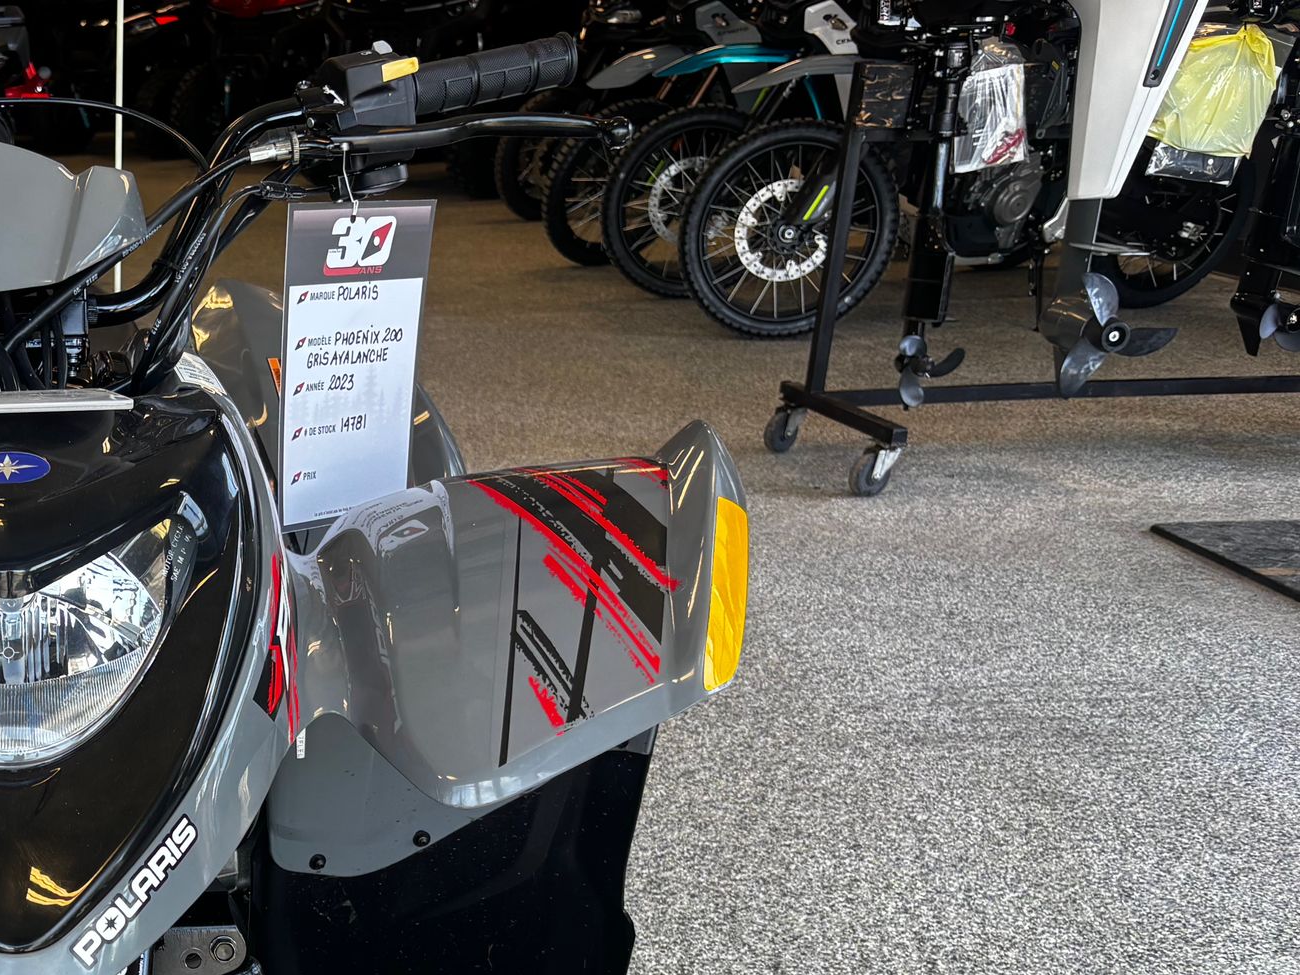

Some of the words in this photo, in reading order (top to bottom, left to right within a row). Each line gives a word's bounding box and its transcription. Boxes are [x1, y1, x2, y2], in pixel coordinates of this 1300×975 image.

[326, 216, 397, 268] 30
[358, 266, 382, 275] ANS
[310, 291, 336, 301] MARQUE
[337, 281, 379, 301] POLARIS
[307, 335, 332, 347] MODÈLE
[382, 328, 403, 343] 200
[307, 348, 329, 369] GRIS
[305, 382, 325, 392] ANNÉE
[327, 374, 355, 391] 2023
[309, 428, 317, 436] DE
[317, 425, 336, 435] STOCK
[340, 414, 367, 433] 14781
[303, 471, 317, 481] PRIX
[73, 817, 196, 967] POLARIS
